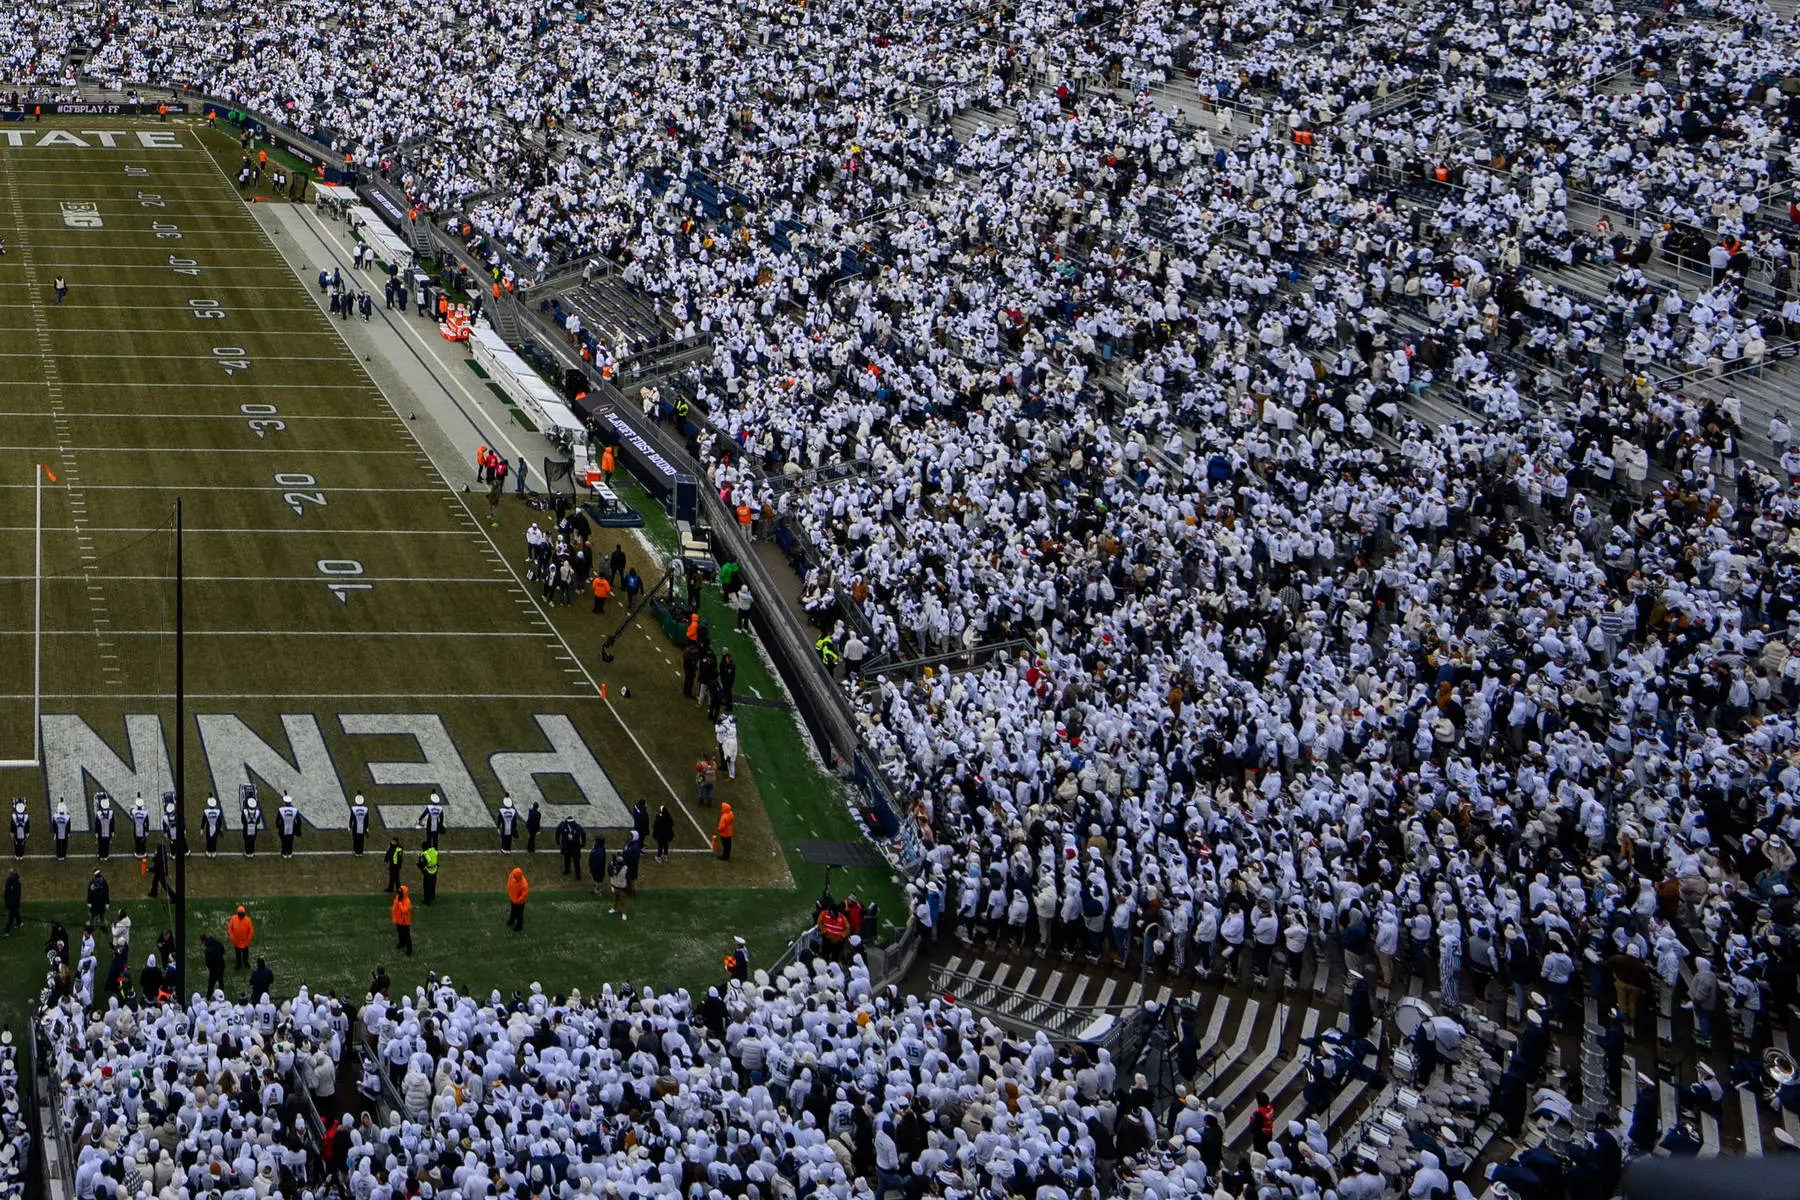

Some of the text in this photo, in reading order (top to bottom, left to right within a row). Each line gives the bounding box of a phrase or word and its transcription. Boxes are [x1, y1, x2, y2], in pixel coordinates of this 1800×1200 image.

[137, 193, 166, 207] 20
[151, 224, 183, 239] 30
[168, 258, 201, 276] 40
[187, 298, 226, 321] 50
[211, 346, 252, 372] 40
[240, 403, 288, 433] 30
[272, 471, 329, 508] 20
[315, 558, 374, 592] 10
[38, 712, 636, 832] PENN
[263, 1013, 270, 1024] 9
[399, 1046, 403, 1057] 1
[907, 1046, 918, 1057] 15
[776, 1061, 787, 1075] 15
